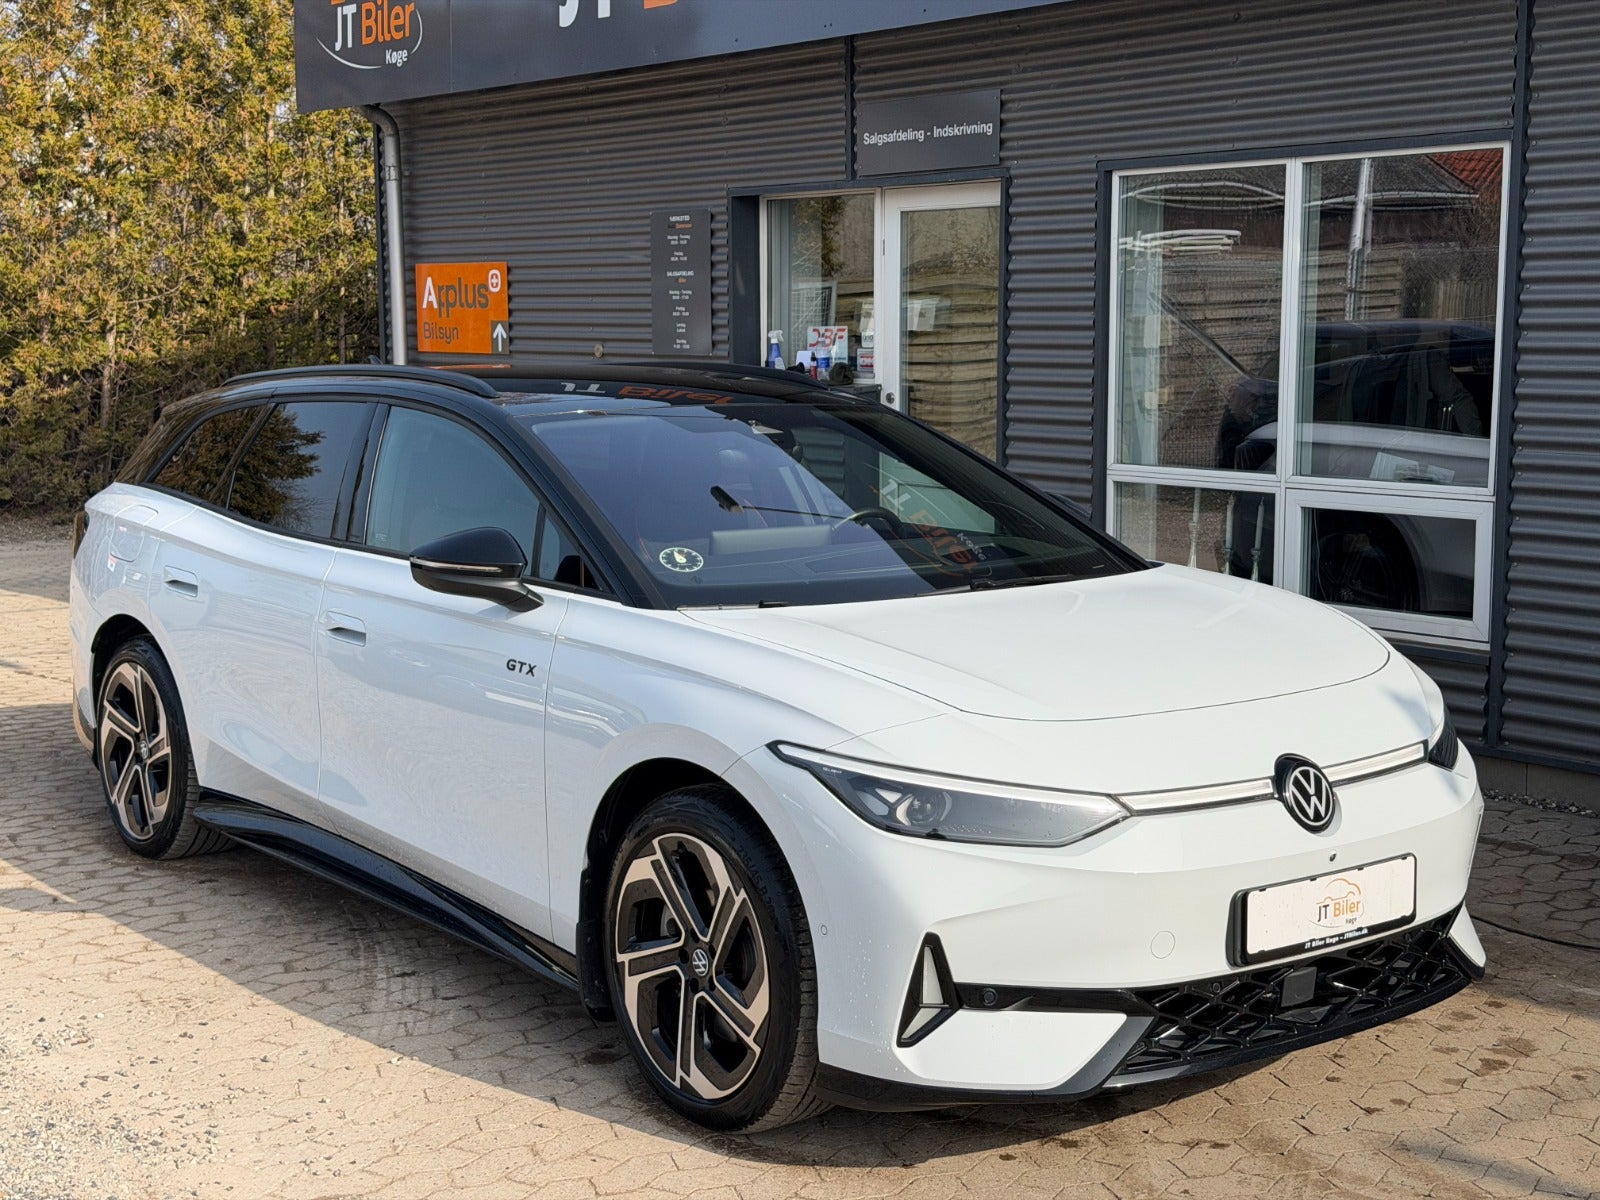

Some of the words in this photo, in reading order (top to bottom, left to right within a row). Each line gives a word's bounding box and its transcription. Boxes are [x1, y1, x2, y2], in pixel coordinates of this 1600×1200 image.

[334, 3, 357, 52] JT
[361, 0, 415, 45] Biler
[385, 48, 408, 67] Køge
[863, 128, 925, 146] Salgsafdeling
[933, 120, 993, 138] Indskrivning
[423, 321, 459, 344] Bilsyn
[506, 658, 537, 677] GTX
[1317, 903, 1330, 922] JT
[1333, 899, 1361, 917] Biler
